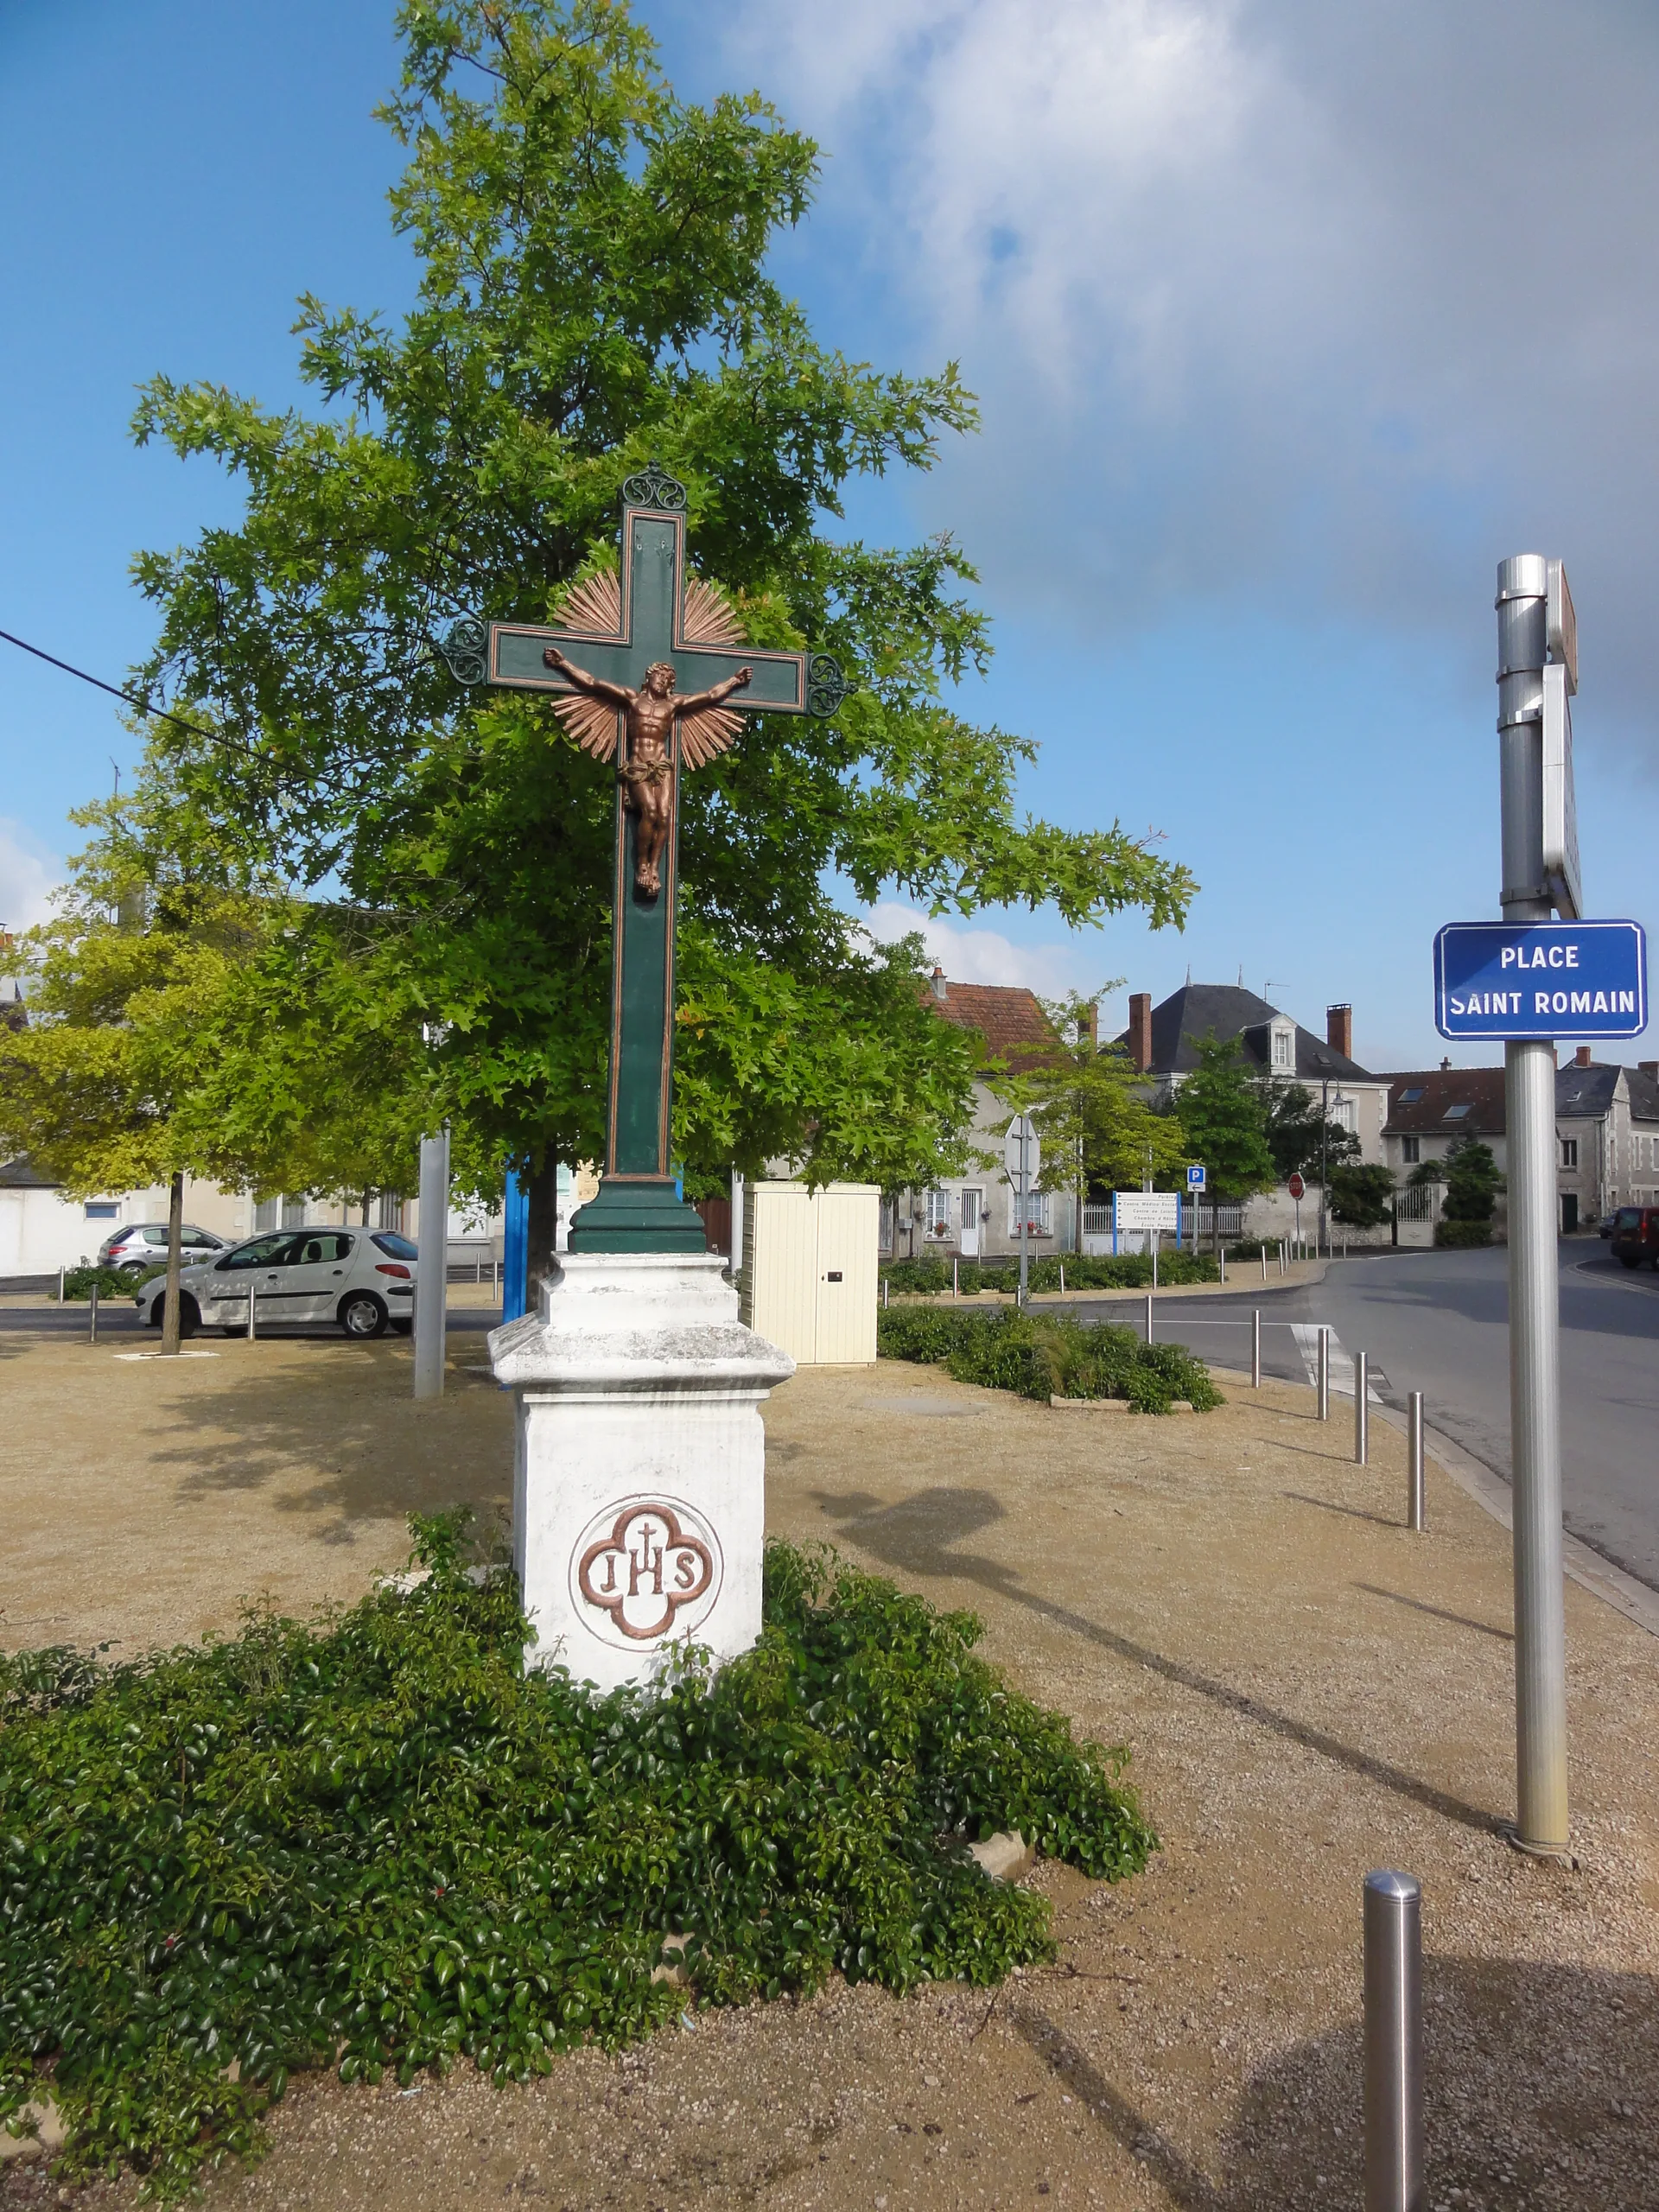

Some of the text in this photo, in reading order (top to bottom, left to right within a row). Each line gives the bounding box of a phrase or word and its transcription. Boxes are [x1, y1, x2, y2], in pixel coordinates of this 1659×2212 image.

[1501, 945, 1579, 969] PLACE
[1450, 991, 1634, 1014] SAINT ROMAIN
[1192, 1170, 1200, 1180] P
